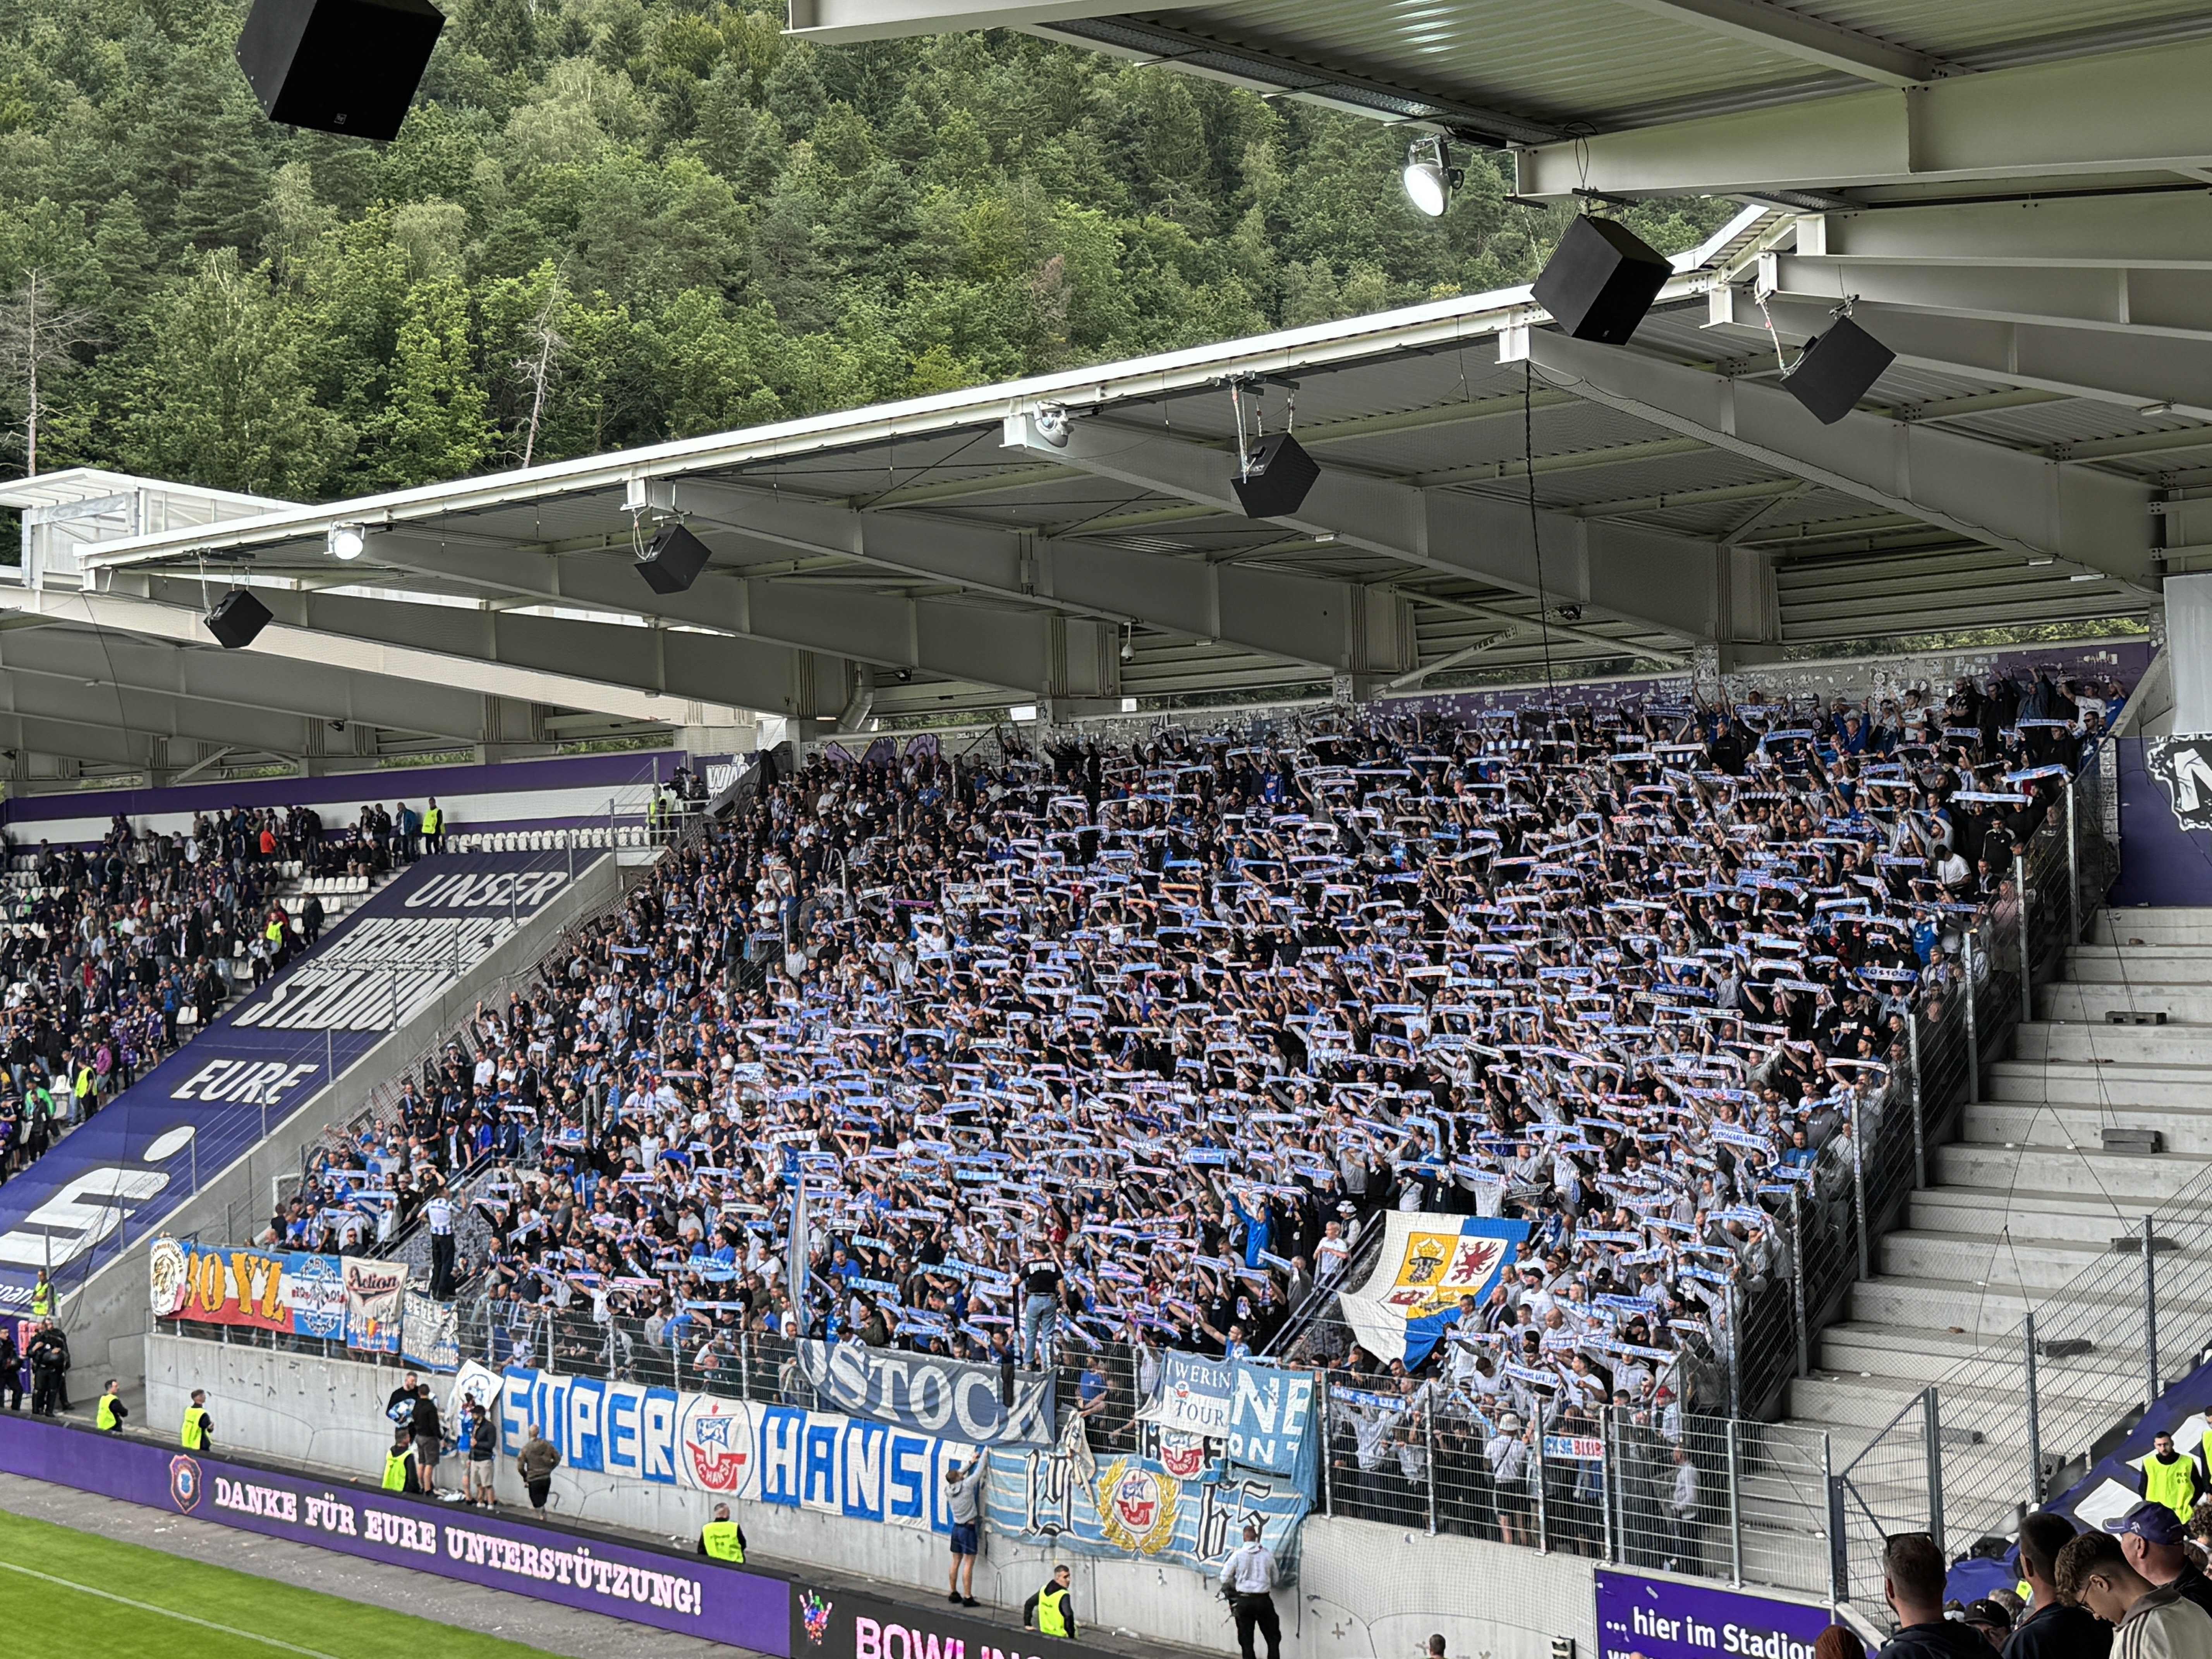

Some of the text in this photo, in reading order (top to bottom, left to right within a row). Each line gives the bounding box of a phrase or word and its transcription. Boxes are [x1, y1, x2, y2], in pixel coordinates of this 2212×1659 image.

[405, 872, 568, 907] UNSER
[231, 967, 467, 1030] STADION
[172, 1059, 319, 1104] EURE
[349, 1266, 398, 1290] Action
[503, 1377, 675, 1478] SUPER
[1175, 1400, 1224, 1426] TOUR
[216, 1477, 701, 1615] DANKE FÜR EURE UNTERSTÜTZUNG!
[1633, 1606, 1680, 1641] hier
[1686, 1616, 1716, 1649] im
